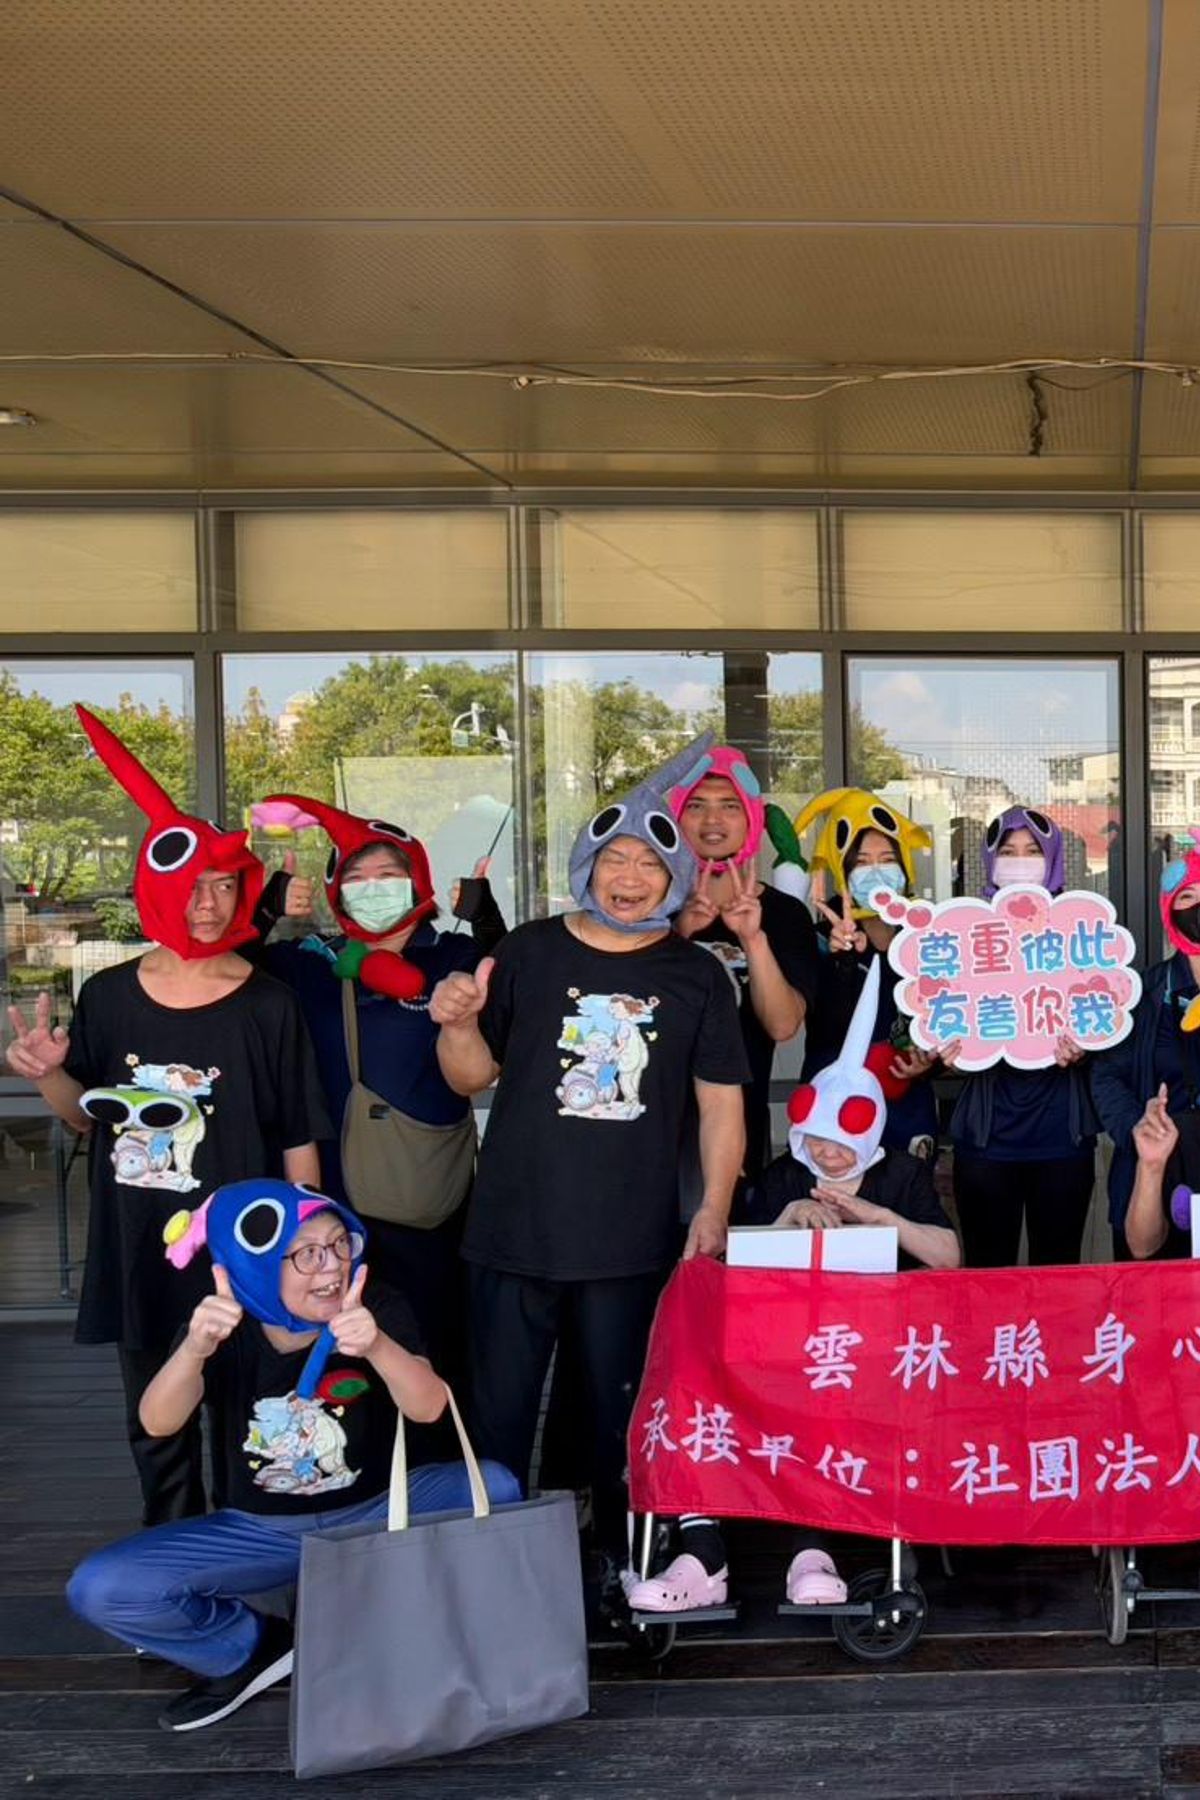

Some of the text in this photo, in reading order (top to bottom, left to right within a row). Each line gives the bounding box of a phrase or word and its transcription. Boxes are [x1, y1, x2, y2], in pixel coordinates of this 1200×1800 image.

[917, 919, 1117, 977] 尊重彼此
[927, 986, 1117, 1041] 友善你我
